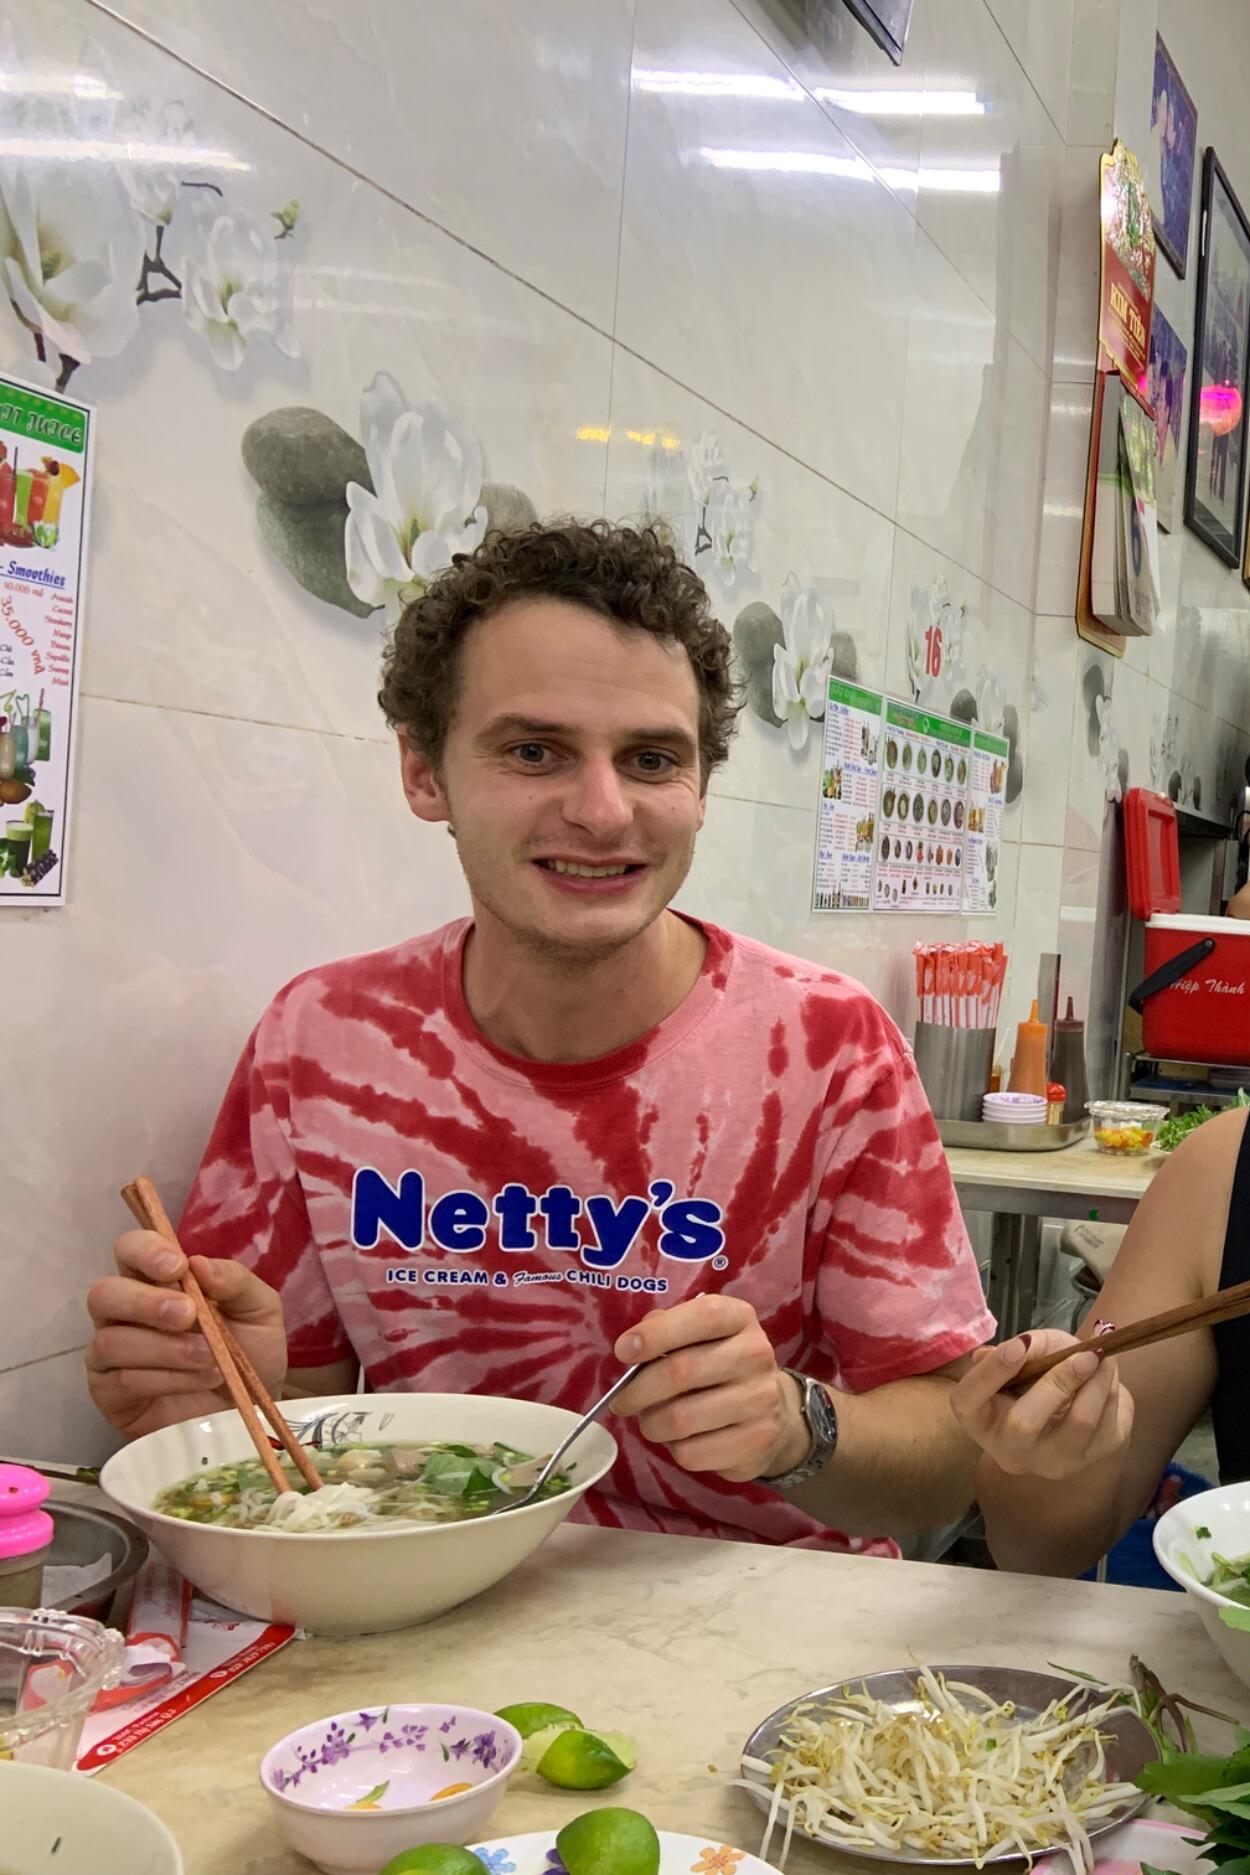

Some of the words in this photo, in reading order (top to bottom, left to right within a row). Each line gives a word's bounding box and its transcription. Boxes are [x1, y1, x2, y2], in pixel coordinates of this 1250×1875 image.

[8, 561, 66, 586] Smoothies
[925, 625, 942, 677] 16
[387, 1269, 417, 1283] ICE
[424, 1270, 488, 1285] CREAM
[494, 1273, 507, 1285] &
[514, 1271, 563, 1286] Famous
[567, 1269, 611, 1287] CHILI
[617, 1276, 668, 1292] DOGS
